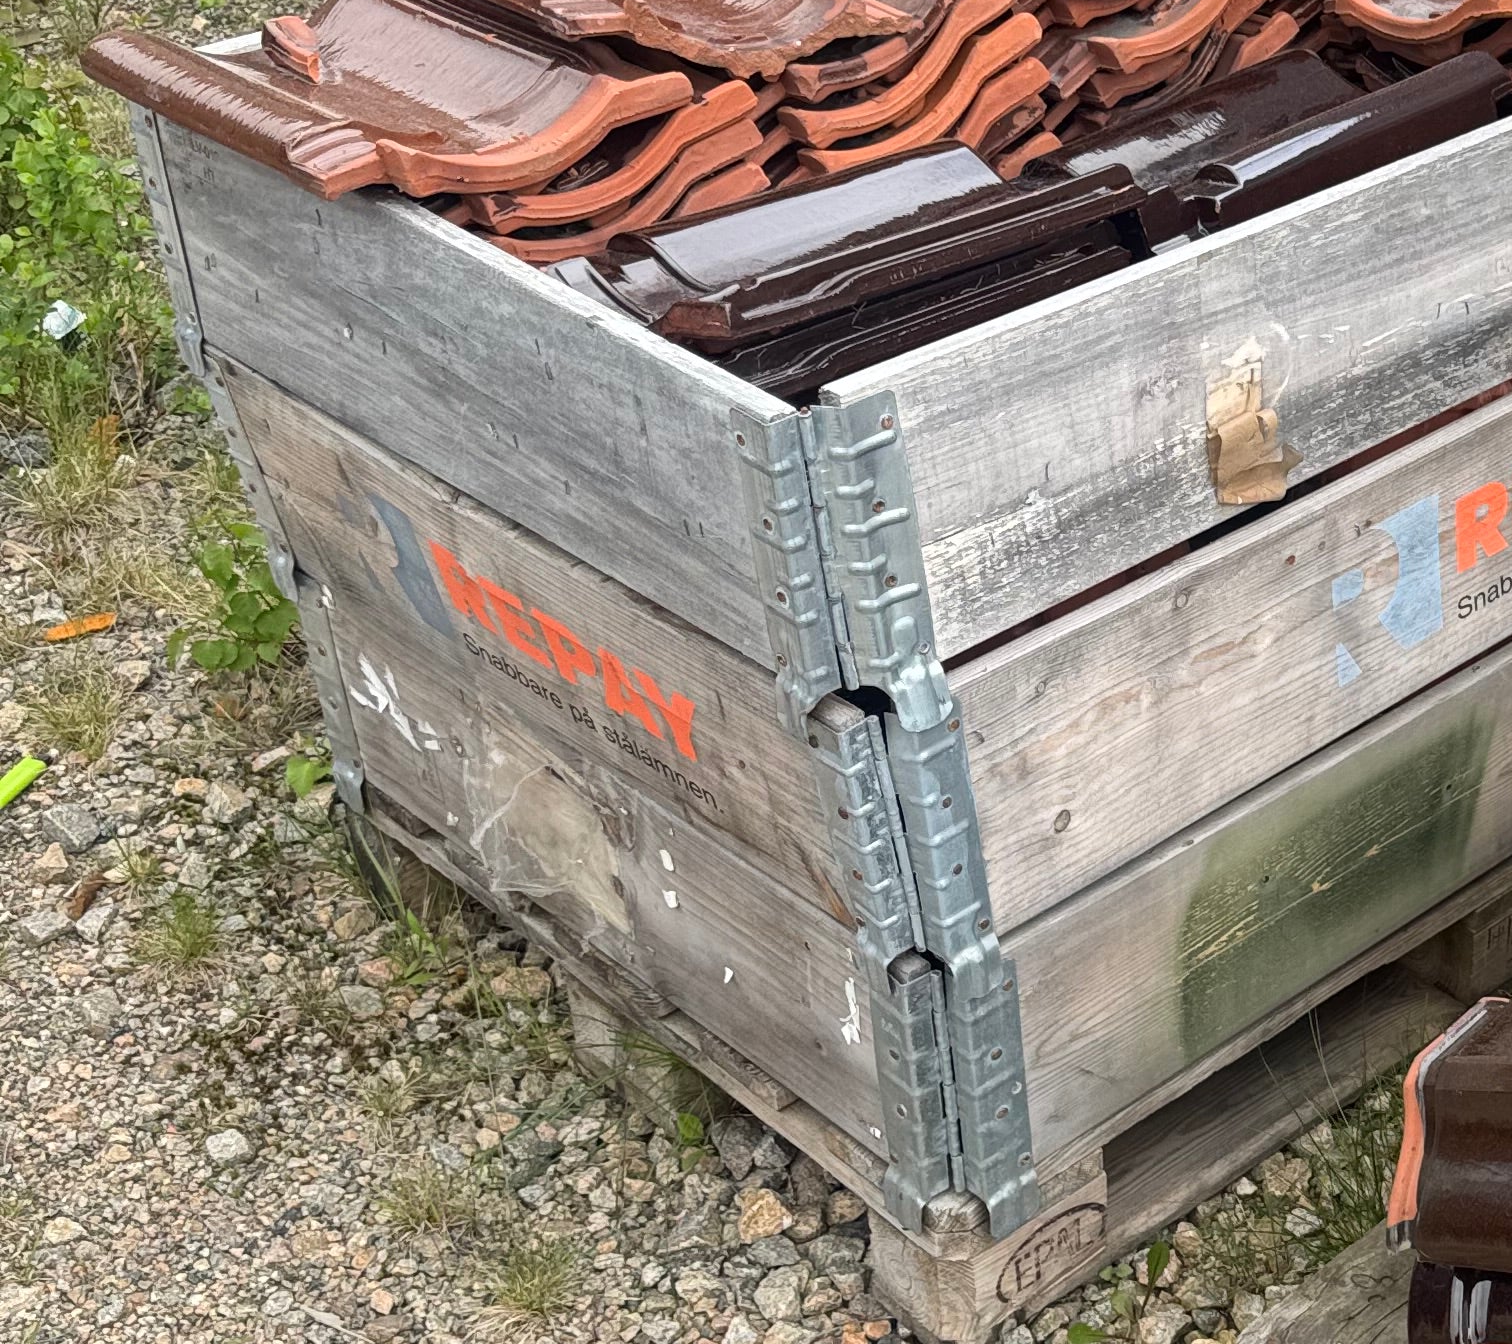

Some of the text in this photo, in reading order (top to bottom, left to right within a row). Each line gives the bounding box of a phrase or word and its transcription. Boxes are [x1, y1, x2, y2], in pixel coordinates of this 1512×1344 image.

[429, 540, 697, 762] REPAY
[463, 632, 724, 814] Snabbare på stålämnen.
